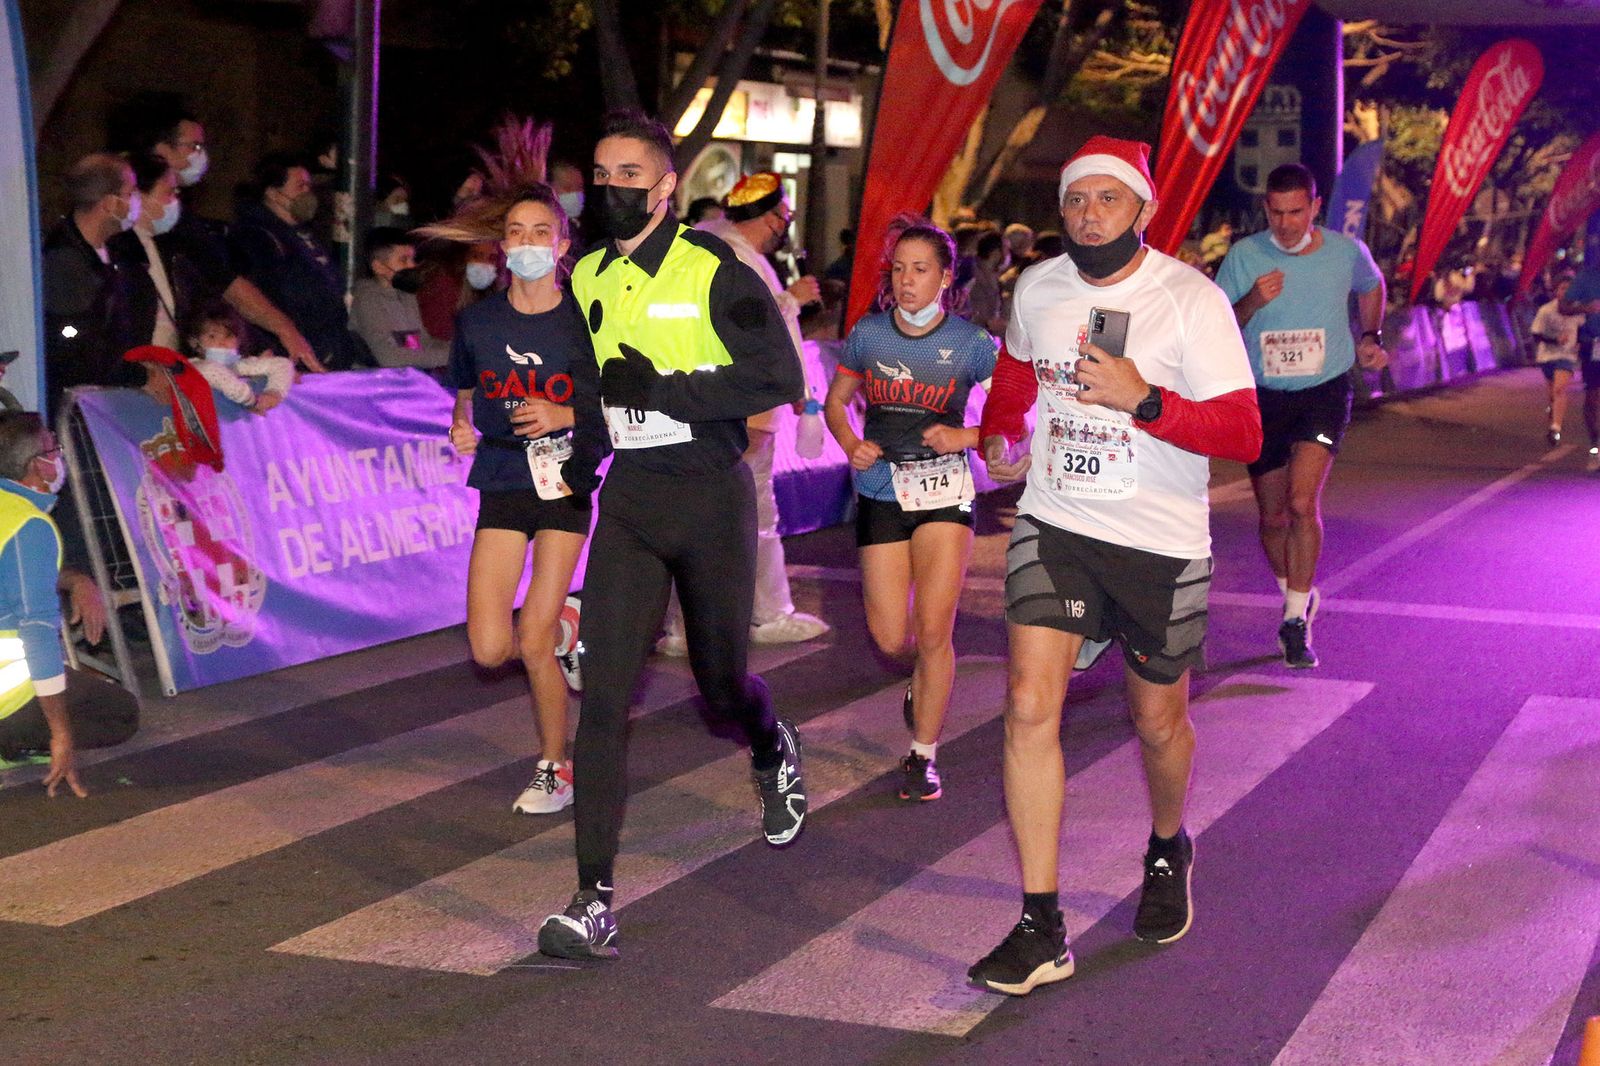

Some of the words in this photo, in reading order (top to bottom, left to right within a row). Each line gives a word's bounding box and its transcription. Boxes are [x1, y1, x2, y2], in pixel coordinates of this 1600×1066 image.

[1280, 351, 1303, 363] 321
[480, 369, 574, 403] GALO
[505, 401, 528, 409] SPO
[1063, 452, 1100, 475] 320
[266, 438, 461, 513] AYUNTAMIE
[920, 474, 949, 491] 174
[278, 523, 333, 578] DE
